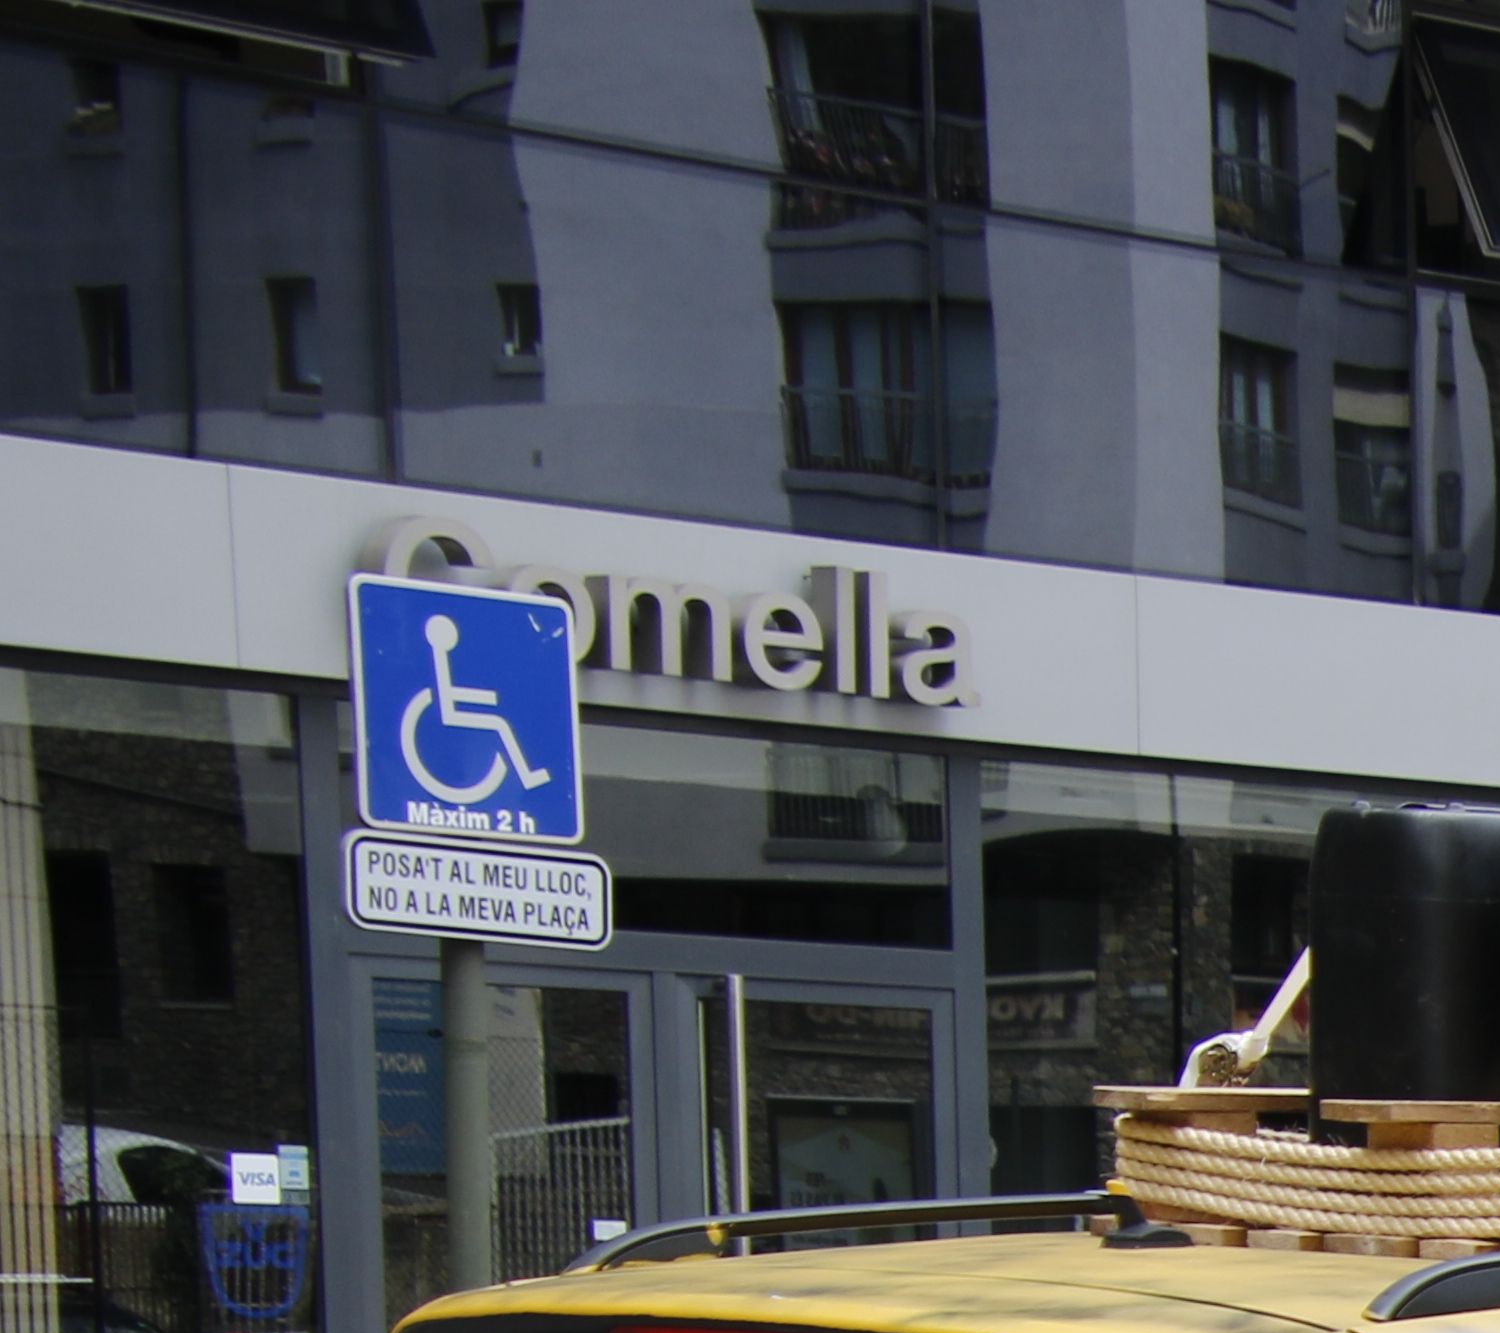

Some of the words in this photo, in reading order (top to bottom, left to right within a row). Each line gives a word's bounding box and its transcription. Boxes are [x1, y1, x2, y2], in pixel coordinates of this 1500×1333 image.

[406, 801, 491, 831] Màxim
[496, 810, 514, 833] 2
[519, 810, 536, 835] h
[367, 850, 443, 881] POSA'T
[449, 860, 476, 886] AL
[482, 863, 528, 891] MEU
[534, 868, 592, 899] LLOC,
[368, 886, 398, 911] NO
[404, 890, 425, 914] A
[425, 893, 452, 918] LA
[458, 896, 517, 924] MEVA
[523, 901, 591, 937] PLAÇA
[238, 1170, 276, 1187] VISA
